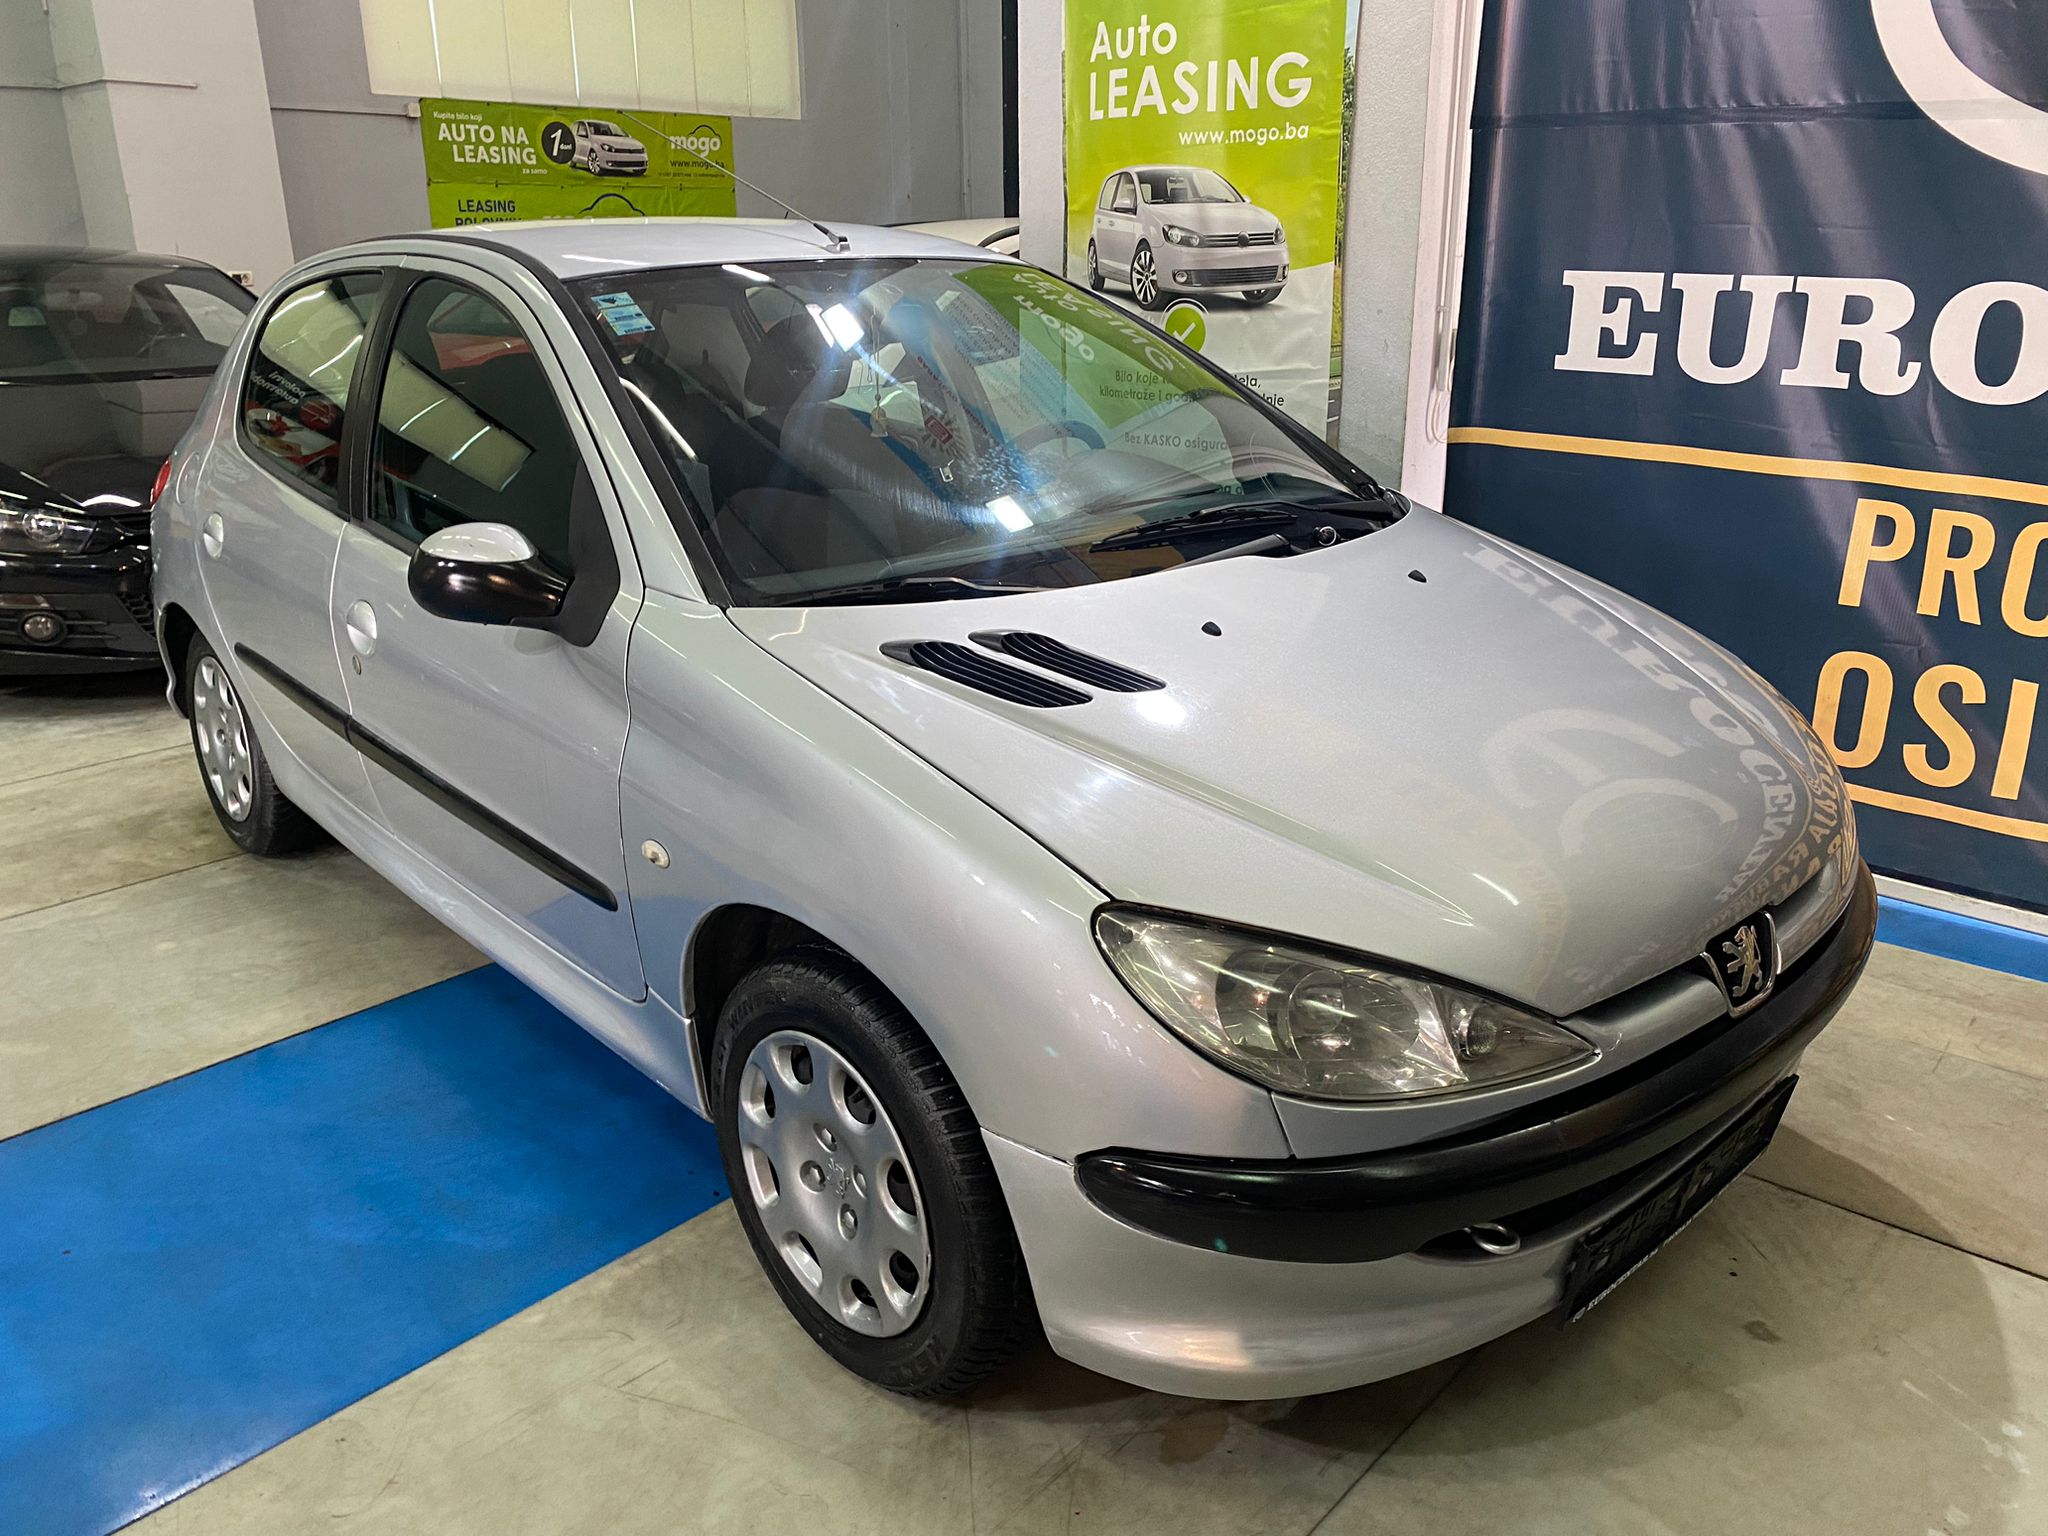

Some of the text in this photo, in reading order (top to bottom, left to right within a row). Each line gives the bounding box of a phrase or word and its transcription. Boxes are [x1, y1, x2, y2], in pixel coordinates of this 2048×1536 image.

[1089, 13, 1178, 63] Auto
[1088, 51, 1312, 122] LEASING
[438, 122, 529, 145] AUTO NA
[550, 128, 563, 157] 1
[1178, 121, 1310, 147] www.mogo.ba
[452, 144, 537, 165] LEASING
[669, 135, 721, 159] mogo
[457, 199, 516, 213] LEASING
[1553, 269, 2048, 405] EURO
[1136, 370, 1159, 387] koje
[1144, 434, 1182, 446] KASKO
[1811, 651, 2039, 800] OSI
